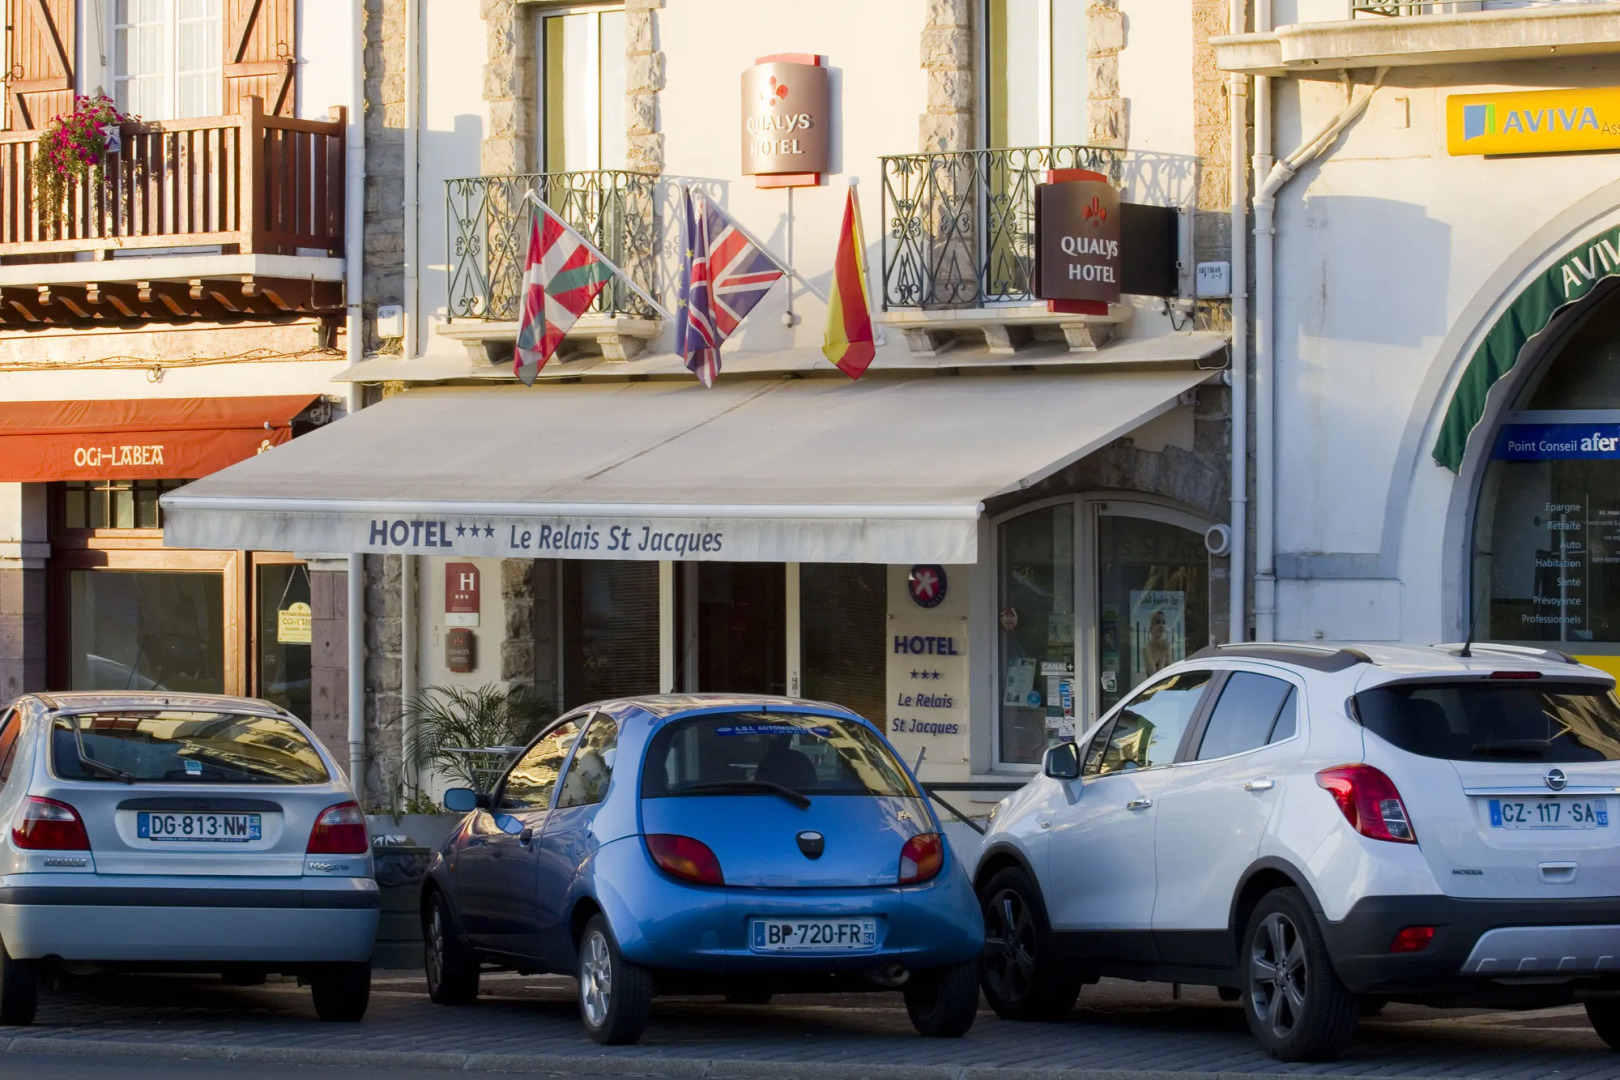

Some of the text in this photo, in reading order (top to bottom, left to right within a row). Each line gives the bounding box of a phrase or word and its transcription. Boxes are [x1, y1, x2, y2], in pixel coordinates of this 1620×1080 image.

[1503, 107, 1599, 134] AVIVA
[750, 140, 802, 156] HOTEL
[1069, 264, 1116, 283] HOTEL
[1508, 433, 1618, 451] Point Conseil afer
[1545, 503, 1581, 513] Epargne
[1547, 521, 1581, 530] Retraite
[369, 520, 723, 557] HOTEL Le Relais St Jacques
[1560, 541, 1581, 549] Auto
[1536, 559, 1581, 567] Habitation
[459, 573, 475, 591] H
[1557, 578, 1581, 586] Santé
[1533, 596, 1581, 607] Prévoyance
[1522, 614, 1581, 624] Professionnels
[894, 635, 958, 655] HOTEL
[898, 693, 953, 708] Le Relais
[892, 718, 958, 736] St Jacques
[152, 815, 247, 835] DG-813-NW
[768, 924, 861, 944] BP-720-FR
